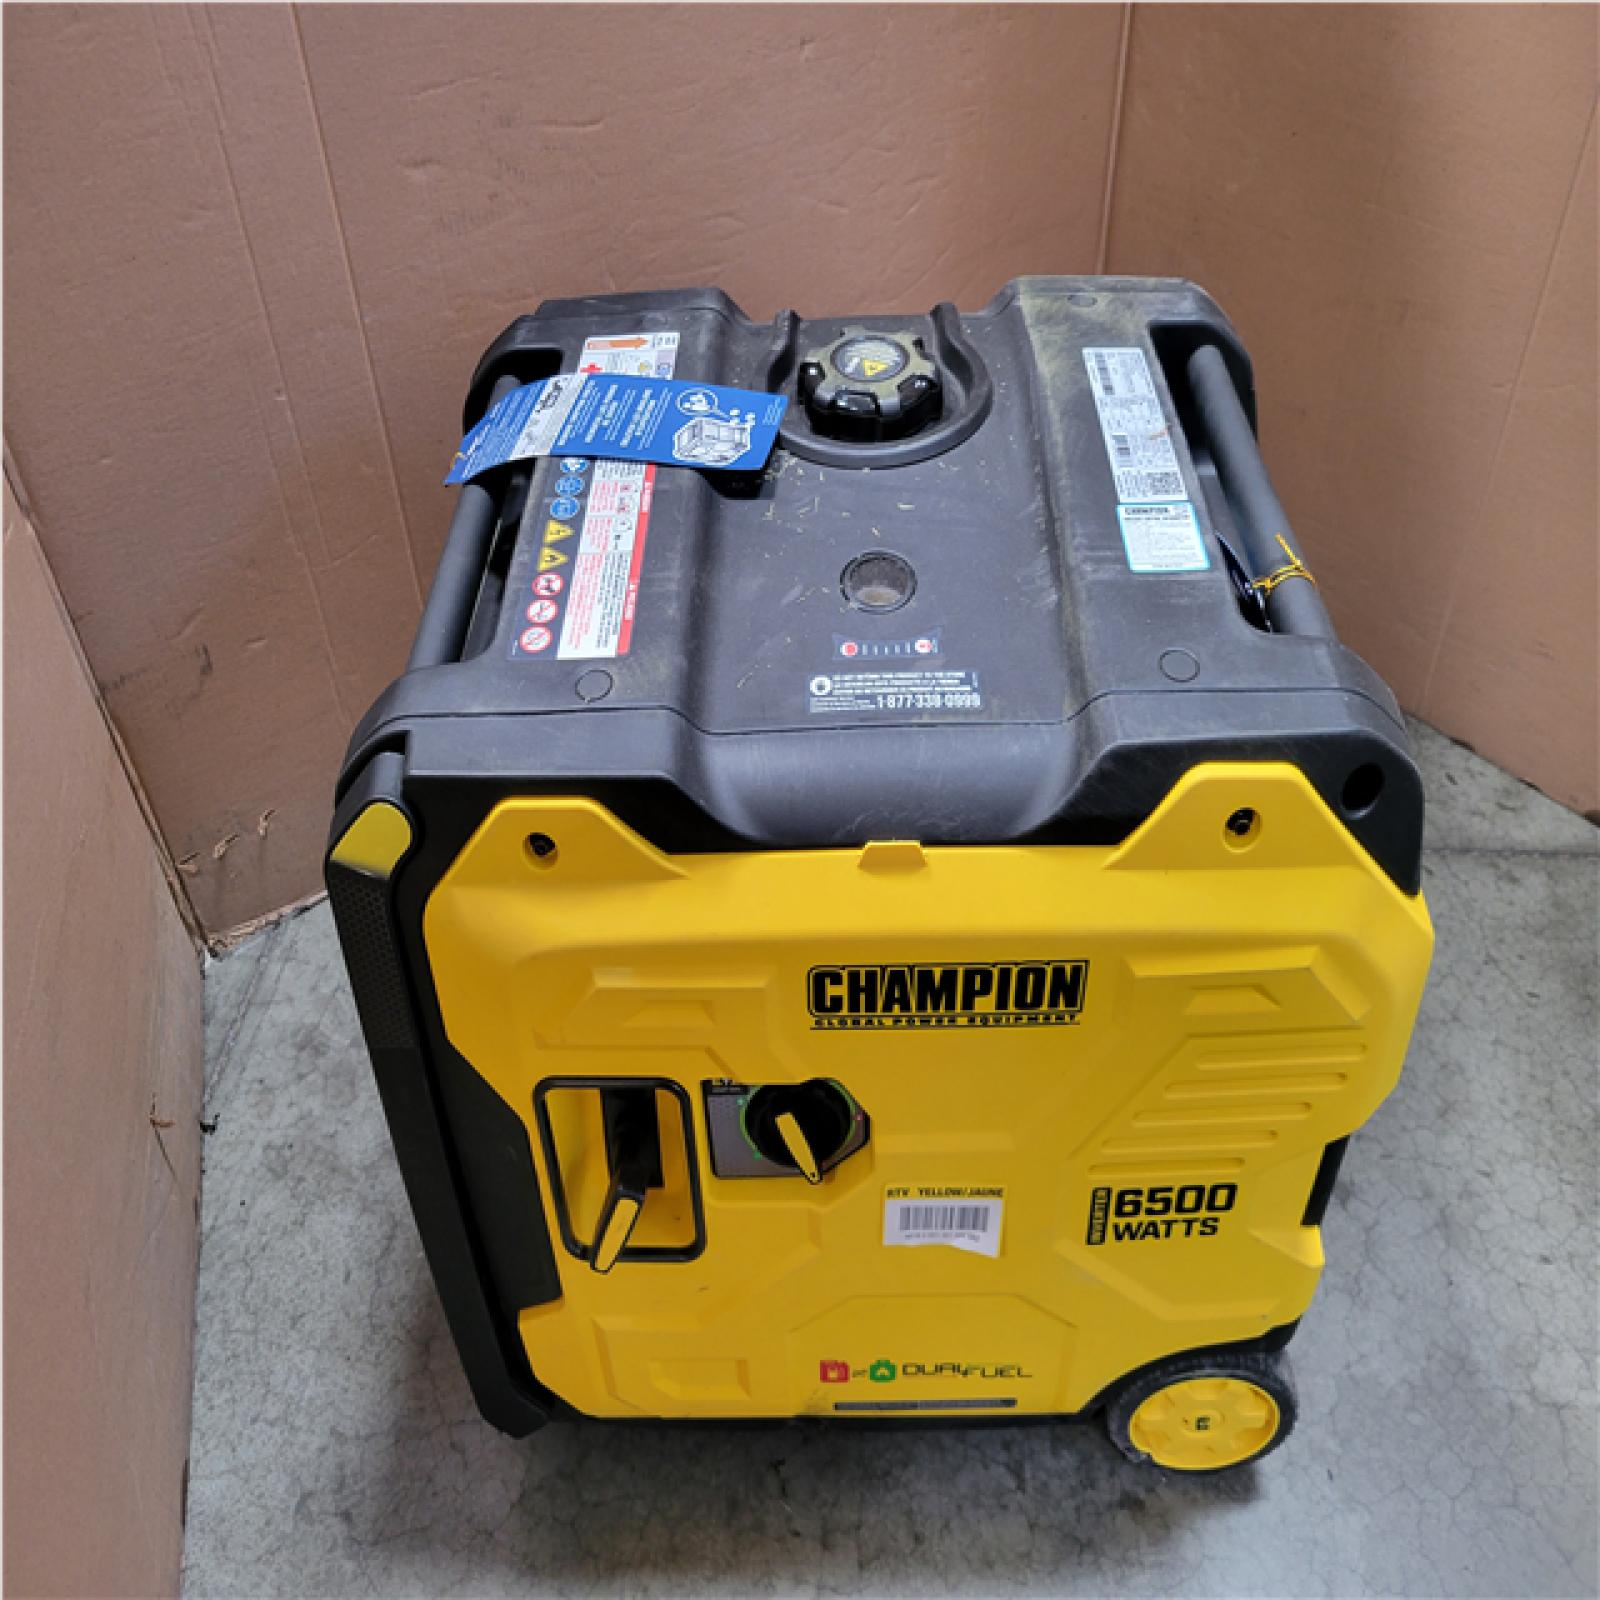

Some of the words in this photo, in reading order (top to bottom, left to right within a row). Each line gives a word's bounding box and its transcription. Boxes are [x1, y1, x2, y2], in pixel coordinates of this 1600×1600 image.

[808, 961, 1088, 1014] CHAMPION
[918, 1187, 1003, 1198] YELLOW/JAUNE
[1114, 1182, 1238, 1218] 6500
[1113, 1217, 1220, 1241] WATTS
